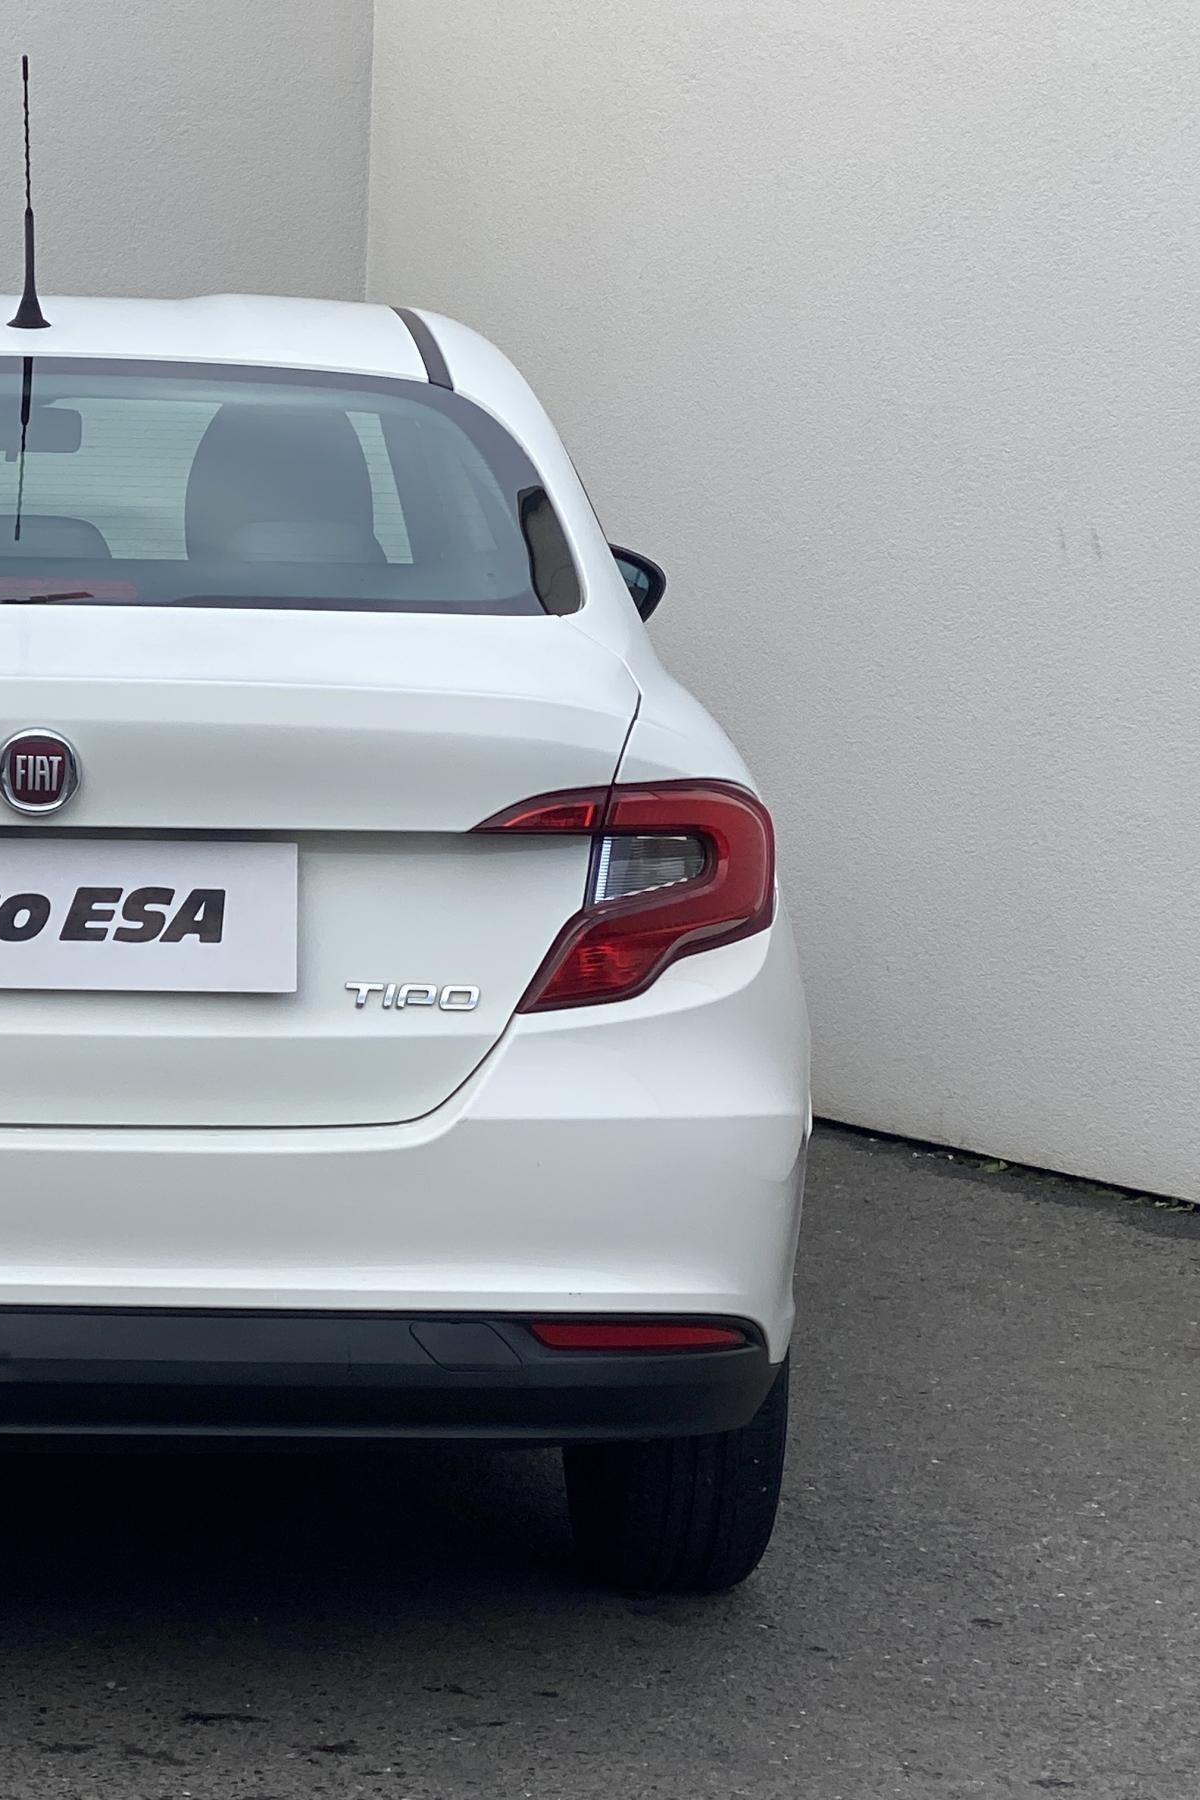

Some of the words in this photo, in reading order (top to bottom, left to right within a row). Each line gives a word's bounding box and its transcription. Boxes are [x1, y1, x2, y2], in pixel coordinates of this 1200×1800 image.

[15, 754, 63, 792] FIAT
[59, 887, 226, 943] ESA
[344, 981, 480, 1012] TIPO
